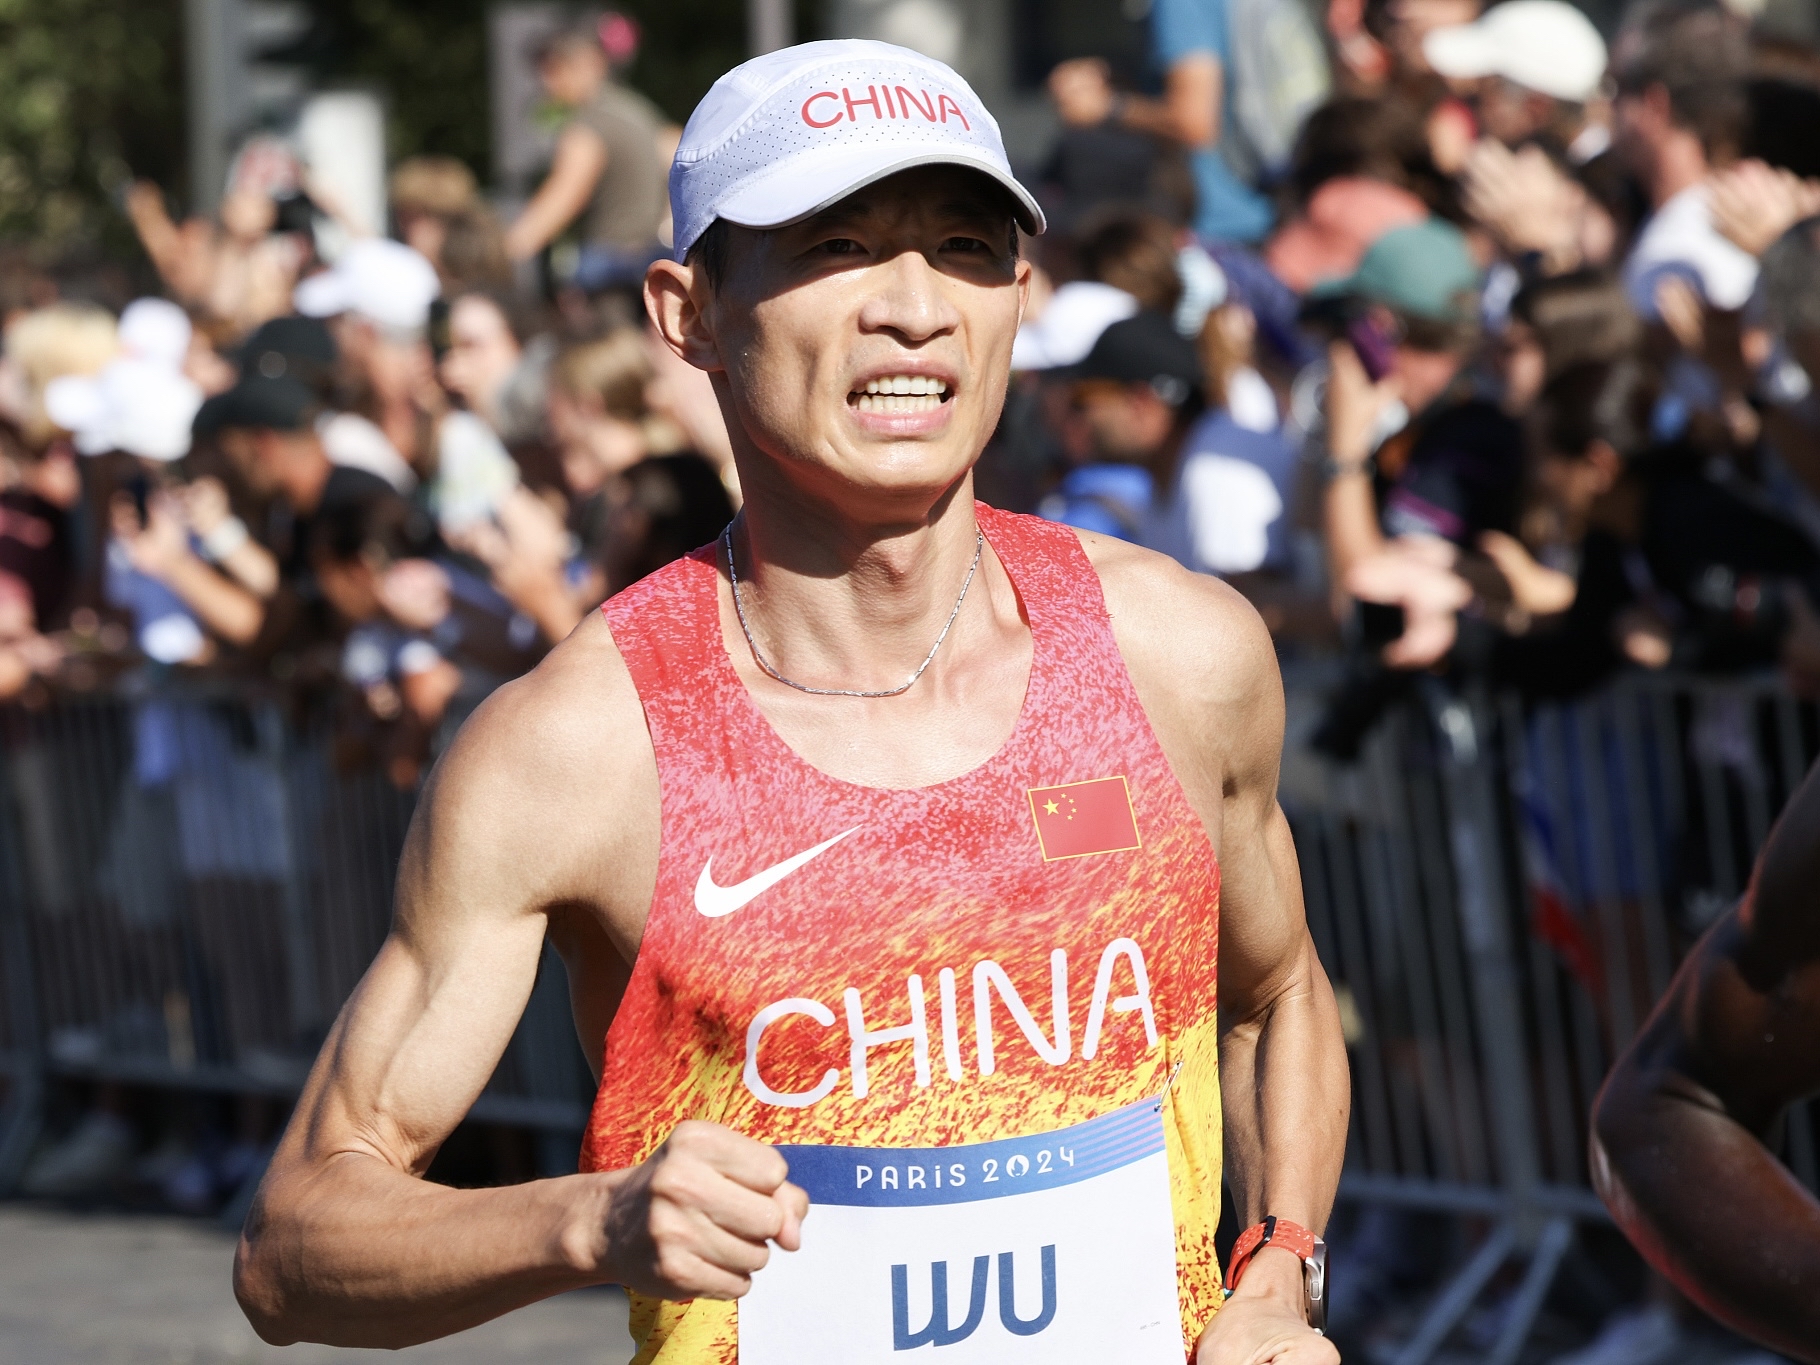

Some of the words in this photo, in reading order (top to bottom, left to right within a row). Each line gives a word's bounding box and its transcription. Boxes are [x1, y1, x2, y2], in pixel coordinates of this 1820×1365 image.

[801, 85, 970, 131] CHINA
[742, 937, 1158, 1108] CHINA
[982, 1146, 1075, 1184] 2024
[891, 1244, 1057, 1352] WU
